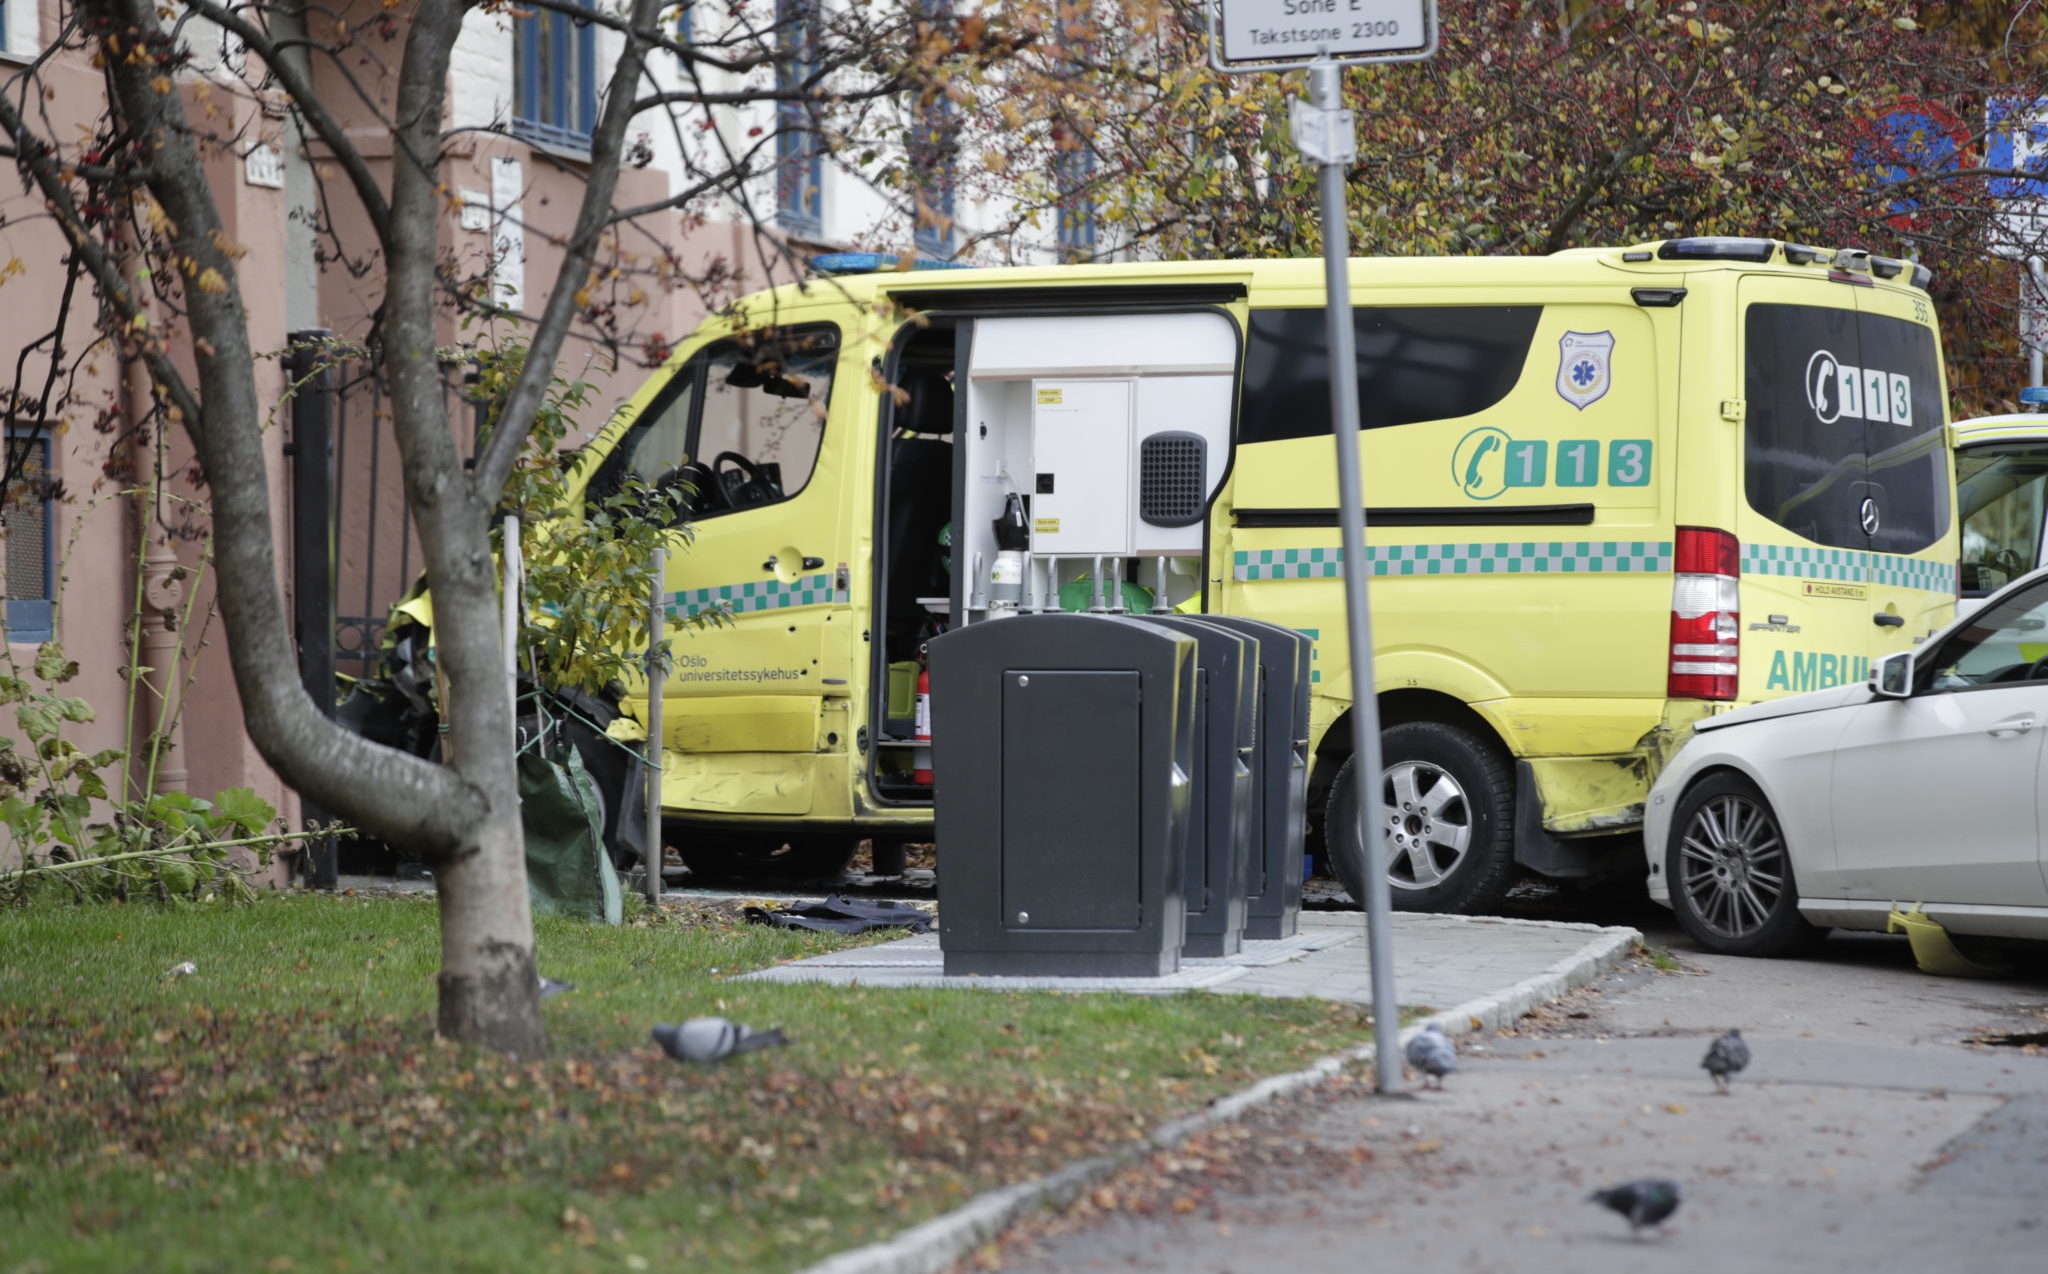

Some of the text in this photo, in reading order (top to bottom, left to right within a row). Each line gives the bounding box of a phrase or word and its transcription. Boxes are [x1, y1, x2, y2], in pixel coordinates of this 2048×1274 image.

[1284, 0, 1336, 15] Sone
[1249, 20, 1399, 45] Takstsone 2300
[1845, 373, 1907, 419] 113
[1516, 444, 1644, 483] 113
[1748, 623, 1801, 633] SPRINTER
[679, 655, 707, 668] Oslo
[679, 667, 799, 683] universitetssykehus
